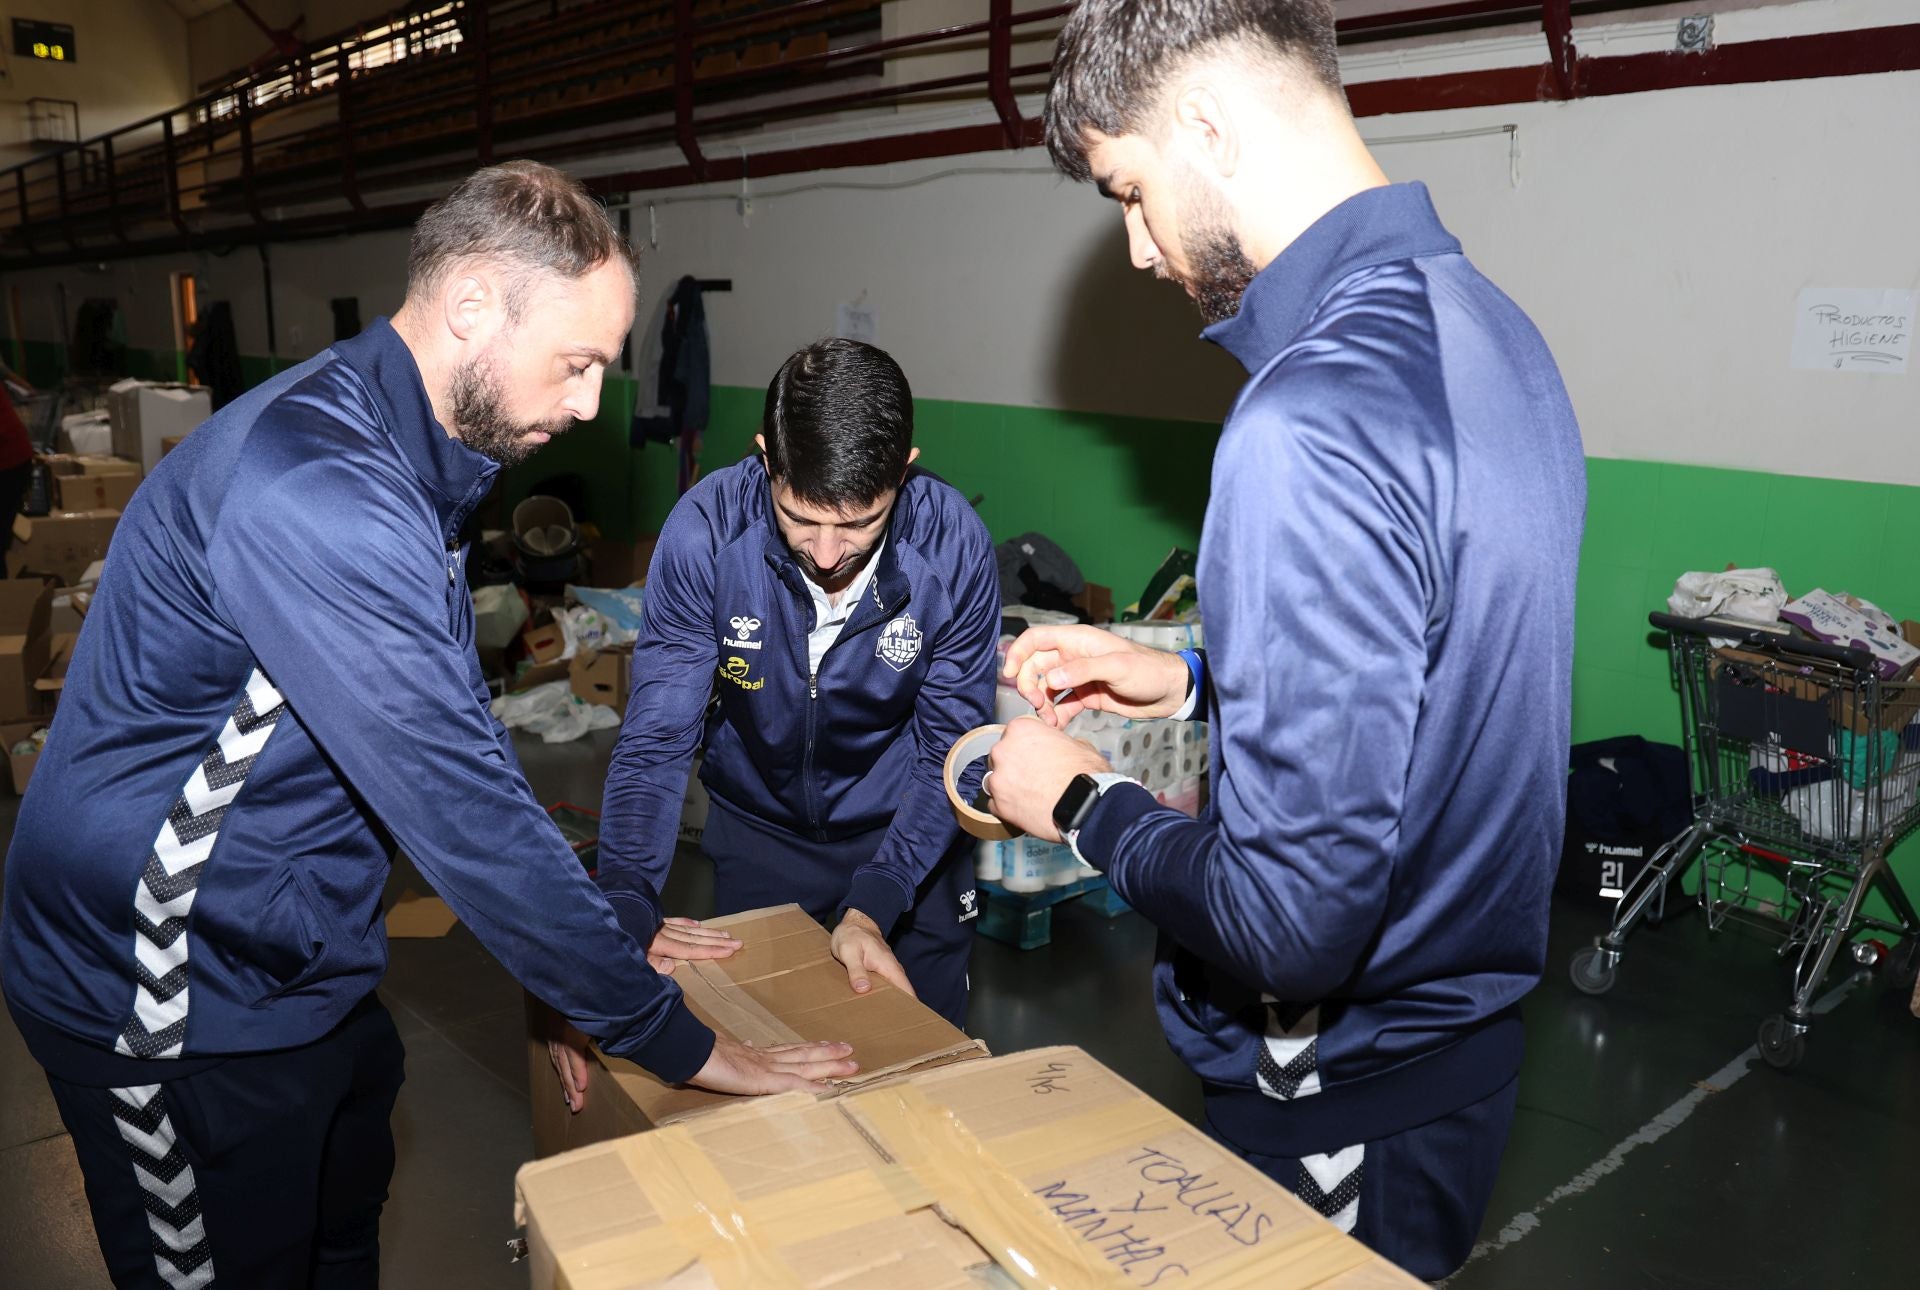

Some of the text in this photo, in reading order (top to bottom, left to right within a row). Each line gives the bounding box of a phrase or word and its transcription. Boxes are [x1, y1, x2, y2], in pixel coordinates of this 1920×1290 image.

[1808, 303, 1907, 329] PRODUCTOS
[723, 636, 762, 650] hummel
[1599, 843, 1643, 857] hummel
[1601, 861, 1624, 888] 21
[1108, 1190, 1169, 1214] Y
